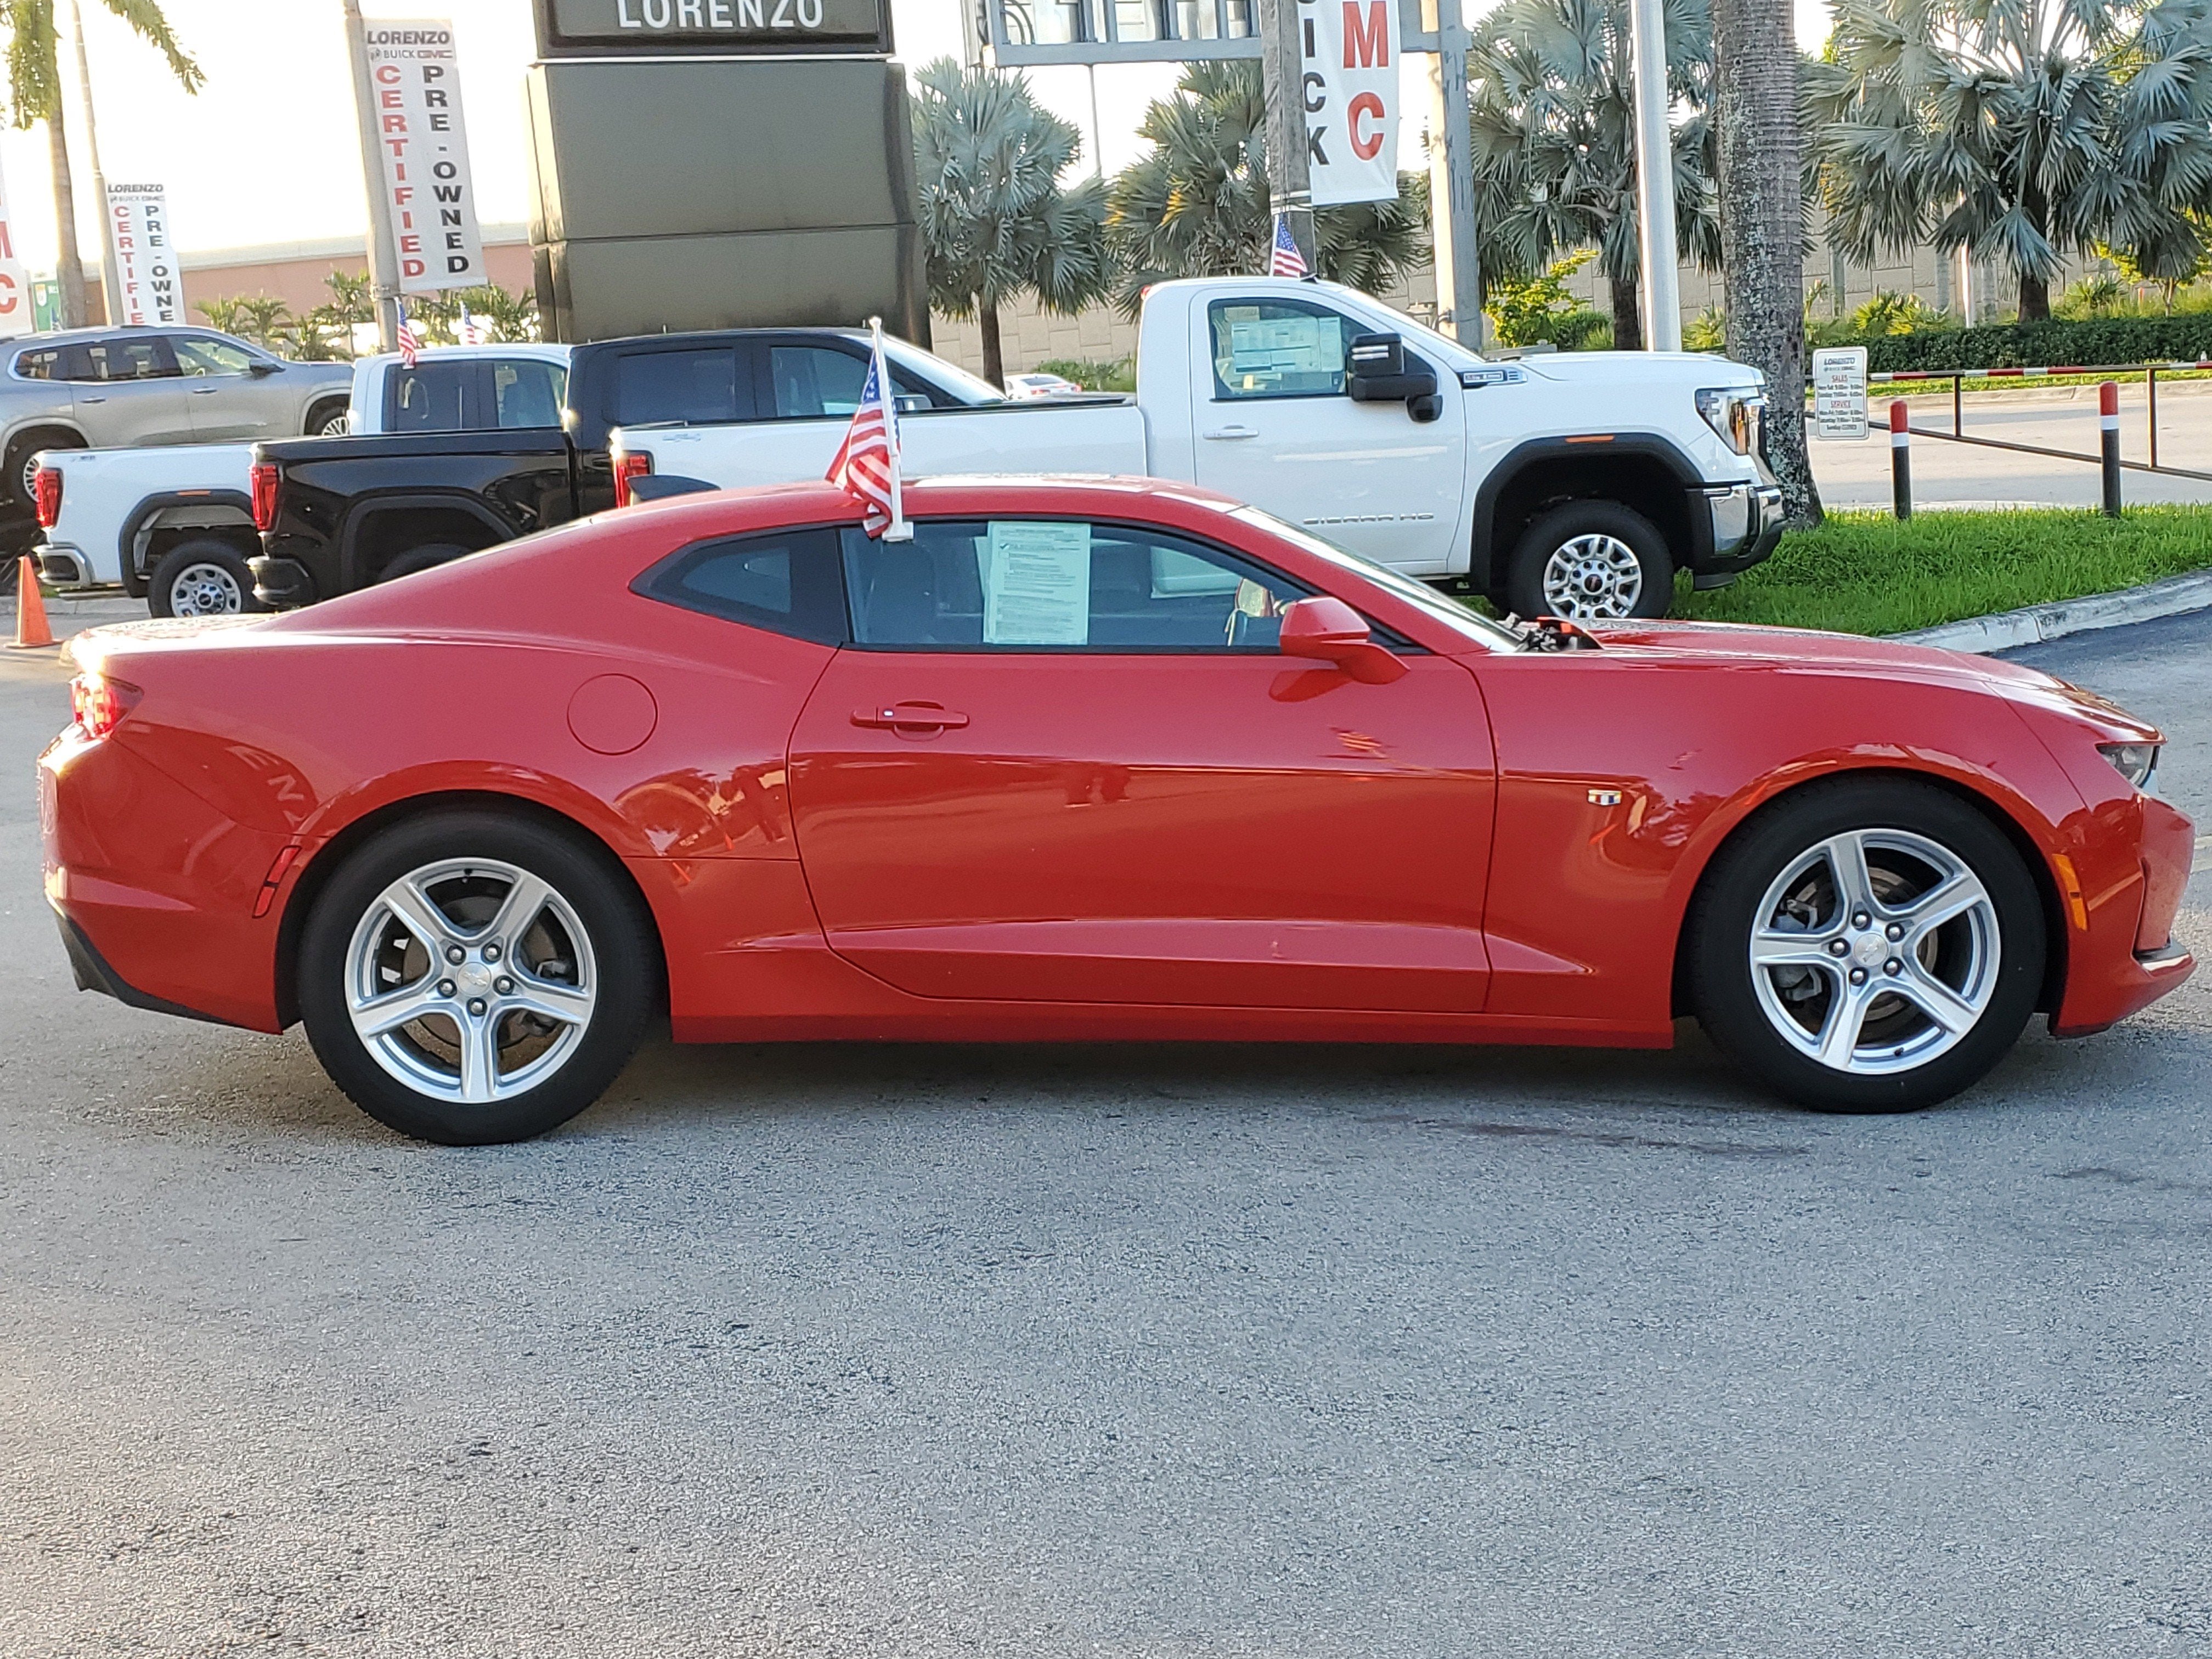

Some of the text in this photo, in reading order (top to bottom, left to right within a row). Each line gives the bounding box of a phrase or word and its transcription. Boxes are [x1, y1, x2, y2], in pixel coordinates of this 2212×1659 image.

[617, 0, 823, 29] LORENZO
[367, 31, 450, 44] LORENZO
[384, 50, 453, 59] BUICK GMC
[1298, 0, 1330, 166] ICK
[376, 65, 425, 278] CERTIFIED
[108, 184, 164, 193] LORENZO
[114, 206, 145, 324] CERTIFIE
[145, 205, 174, 322] PRE-OWNE
[1832, 375, 1848, 383] SALES
[1304, 512, 1434, 524] SIERRA HD
